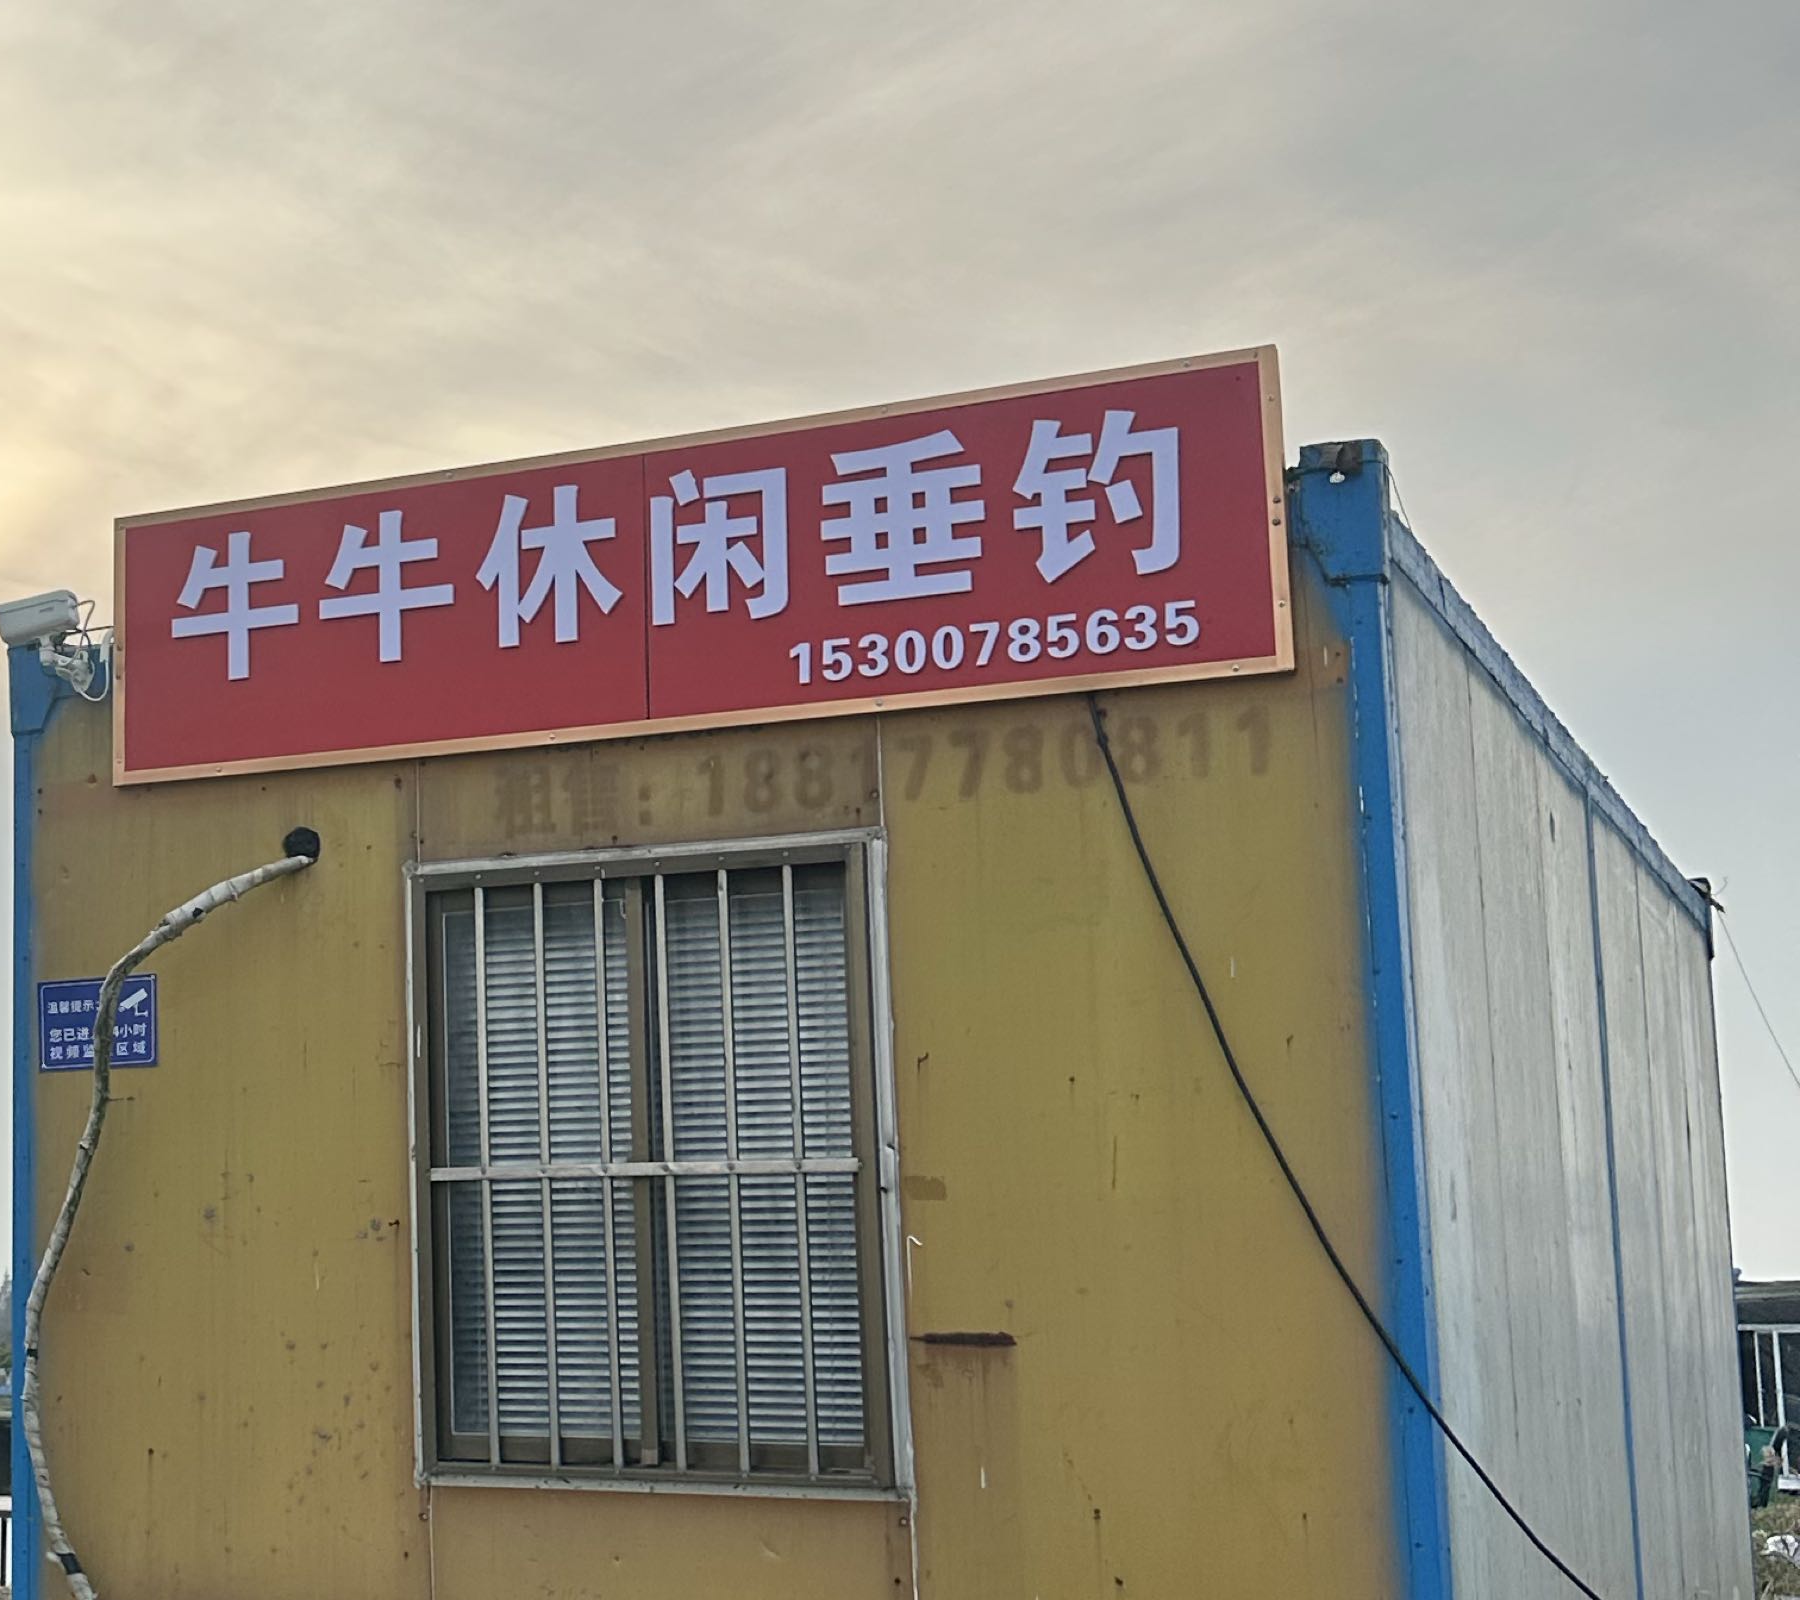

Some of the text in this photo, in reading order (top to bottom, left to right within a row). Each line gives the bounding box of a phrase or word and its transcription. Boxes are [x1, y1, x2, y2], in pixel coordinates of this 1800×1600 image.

[170, 409, 1180, 681] 牛牛休闲垂钓
[788, 600, 1201, 685] 15300785635
[49, 1022, 147, 1043] 您已进4小时
[49, 1040, 146, 1060] 视频监区域
